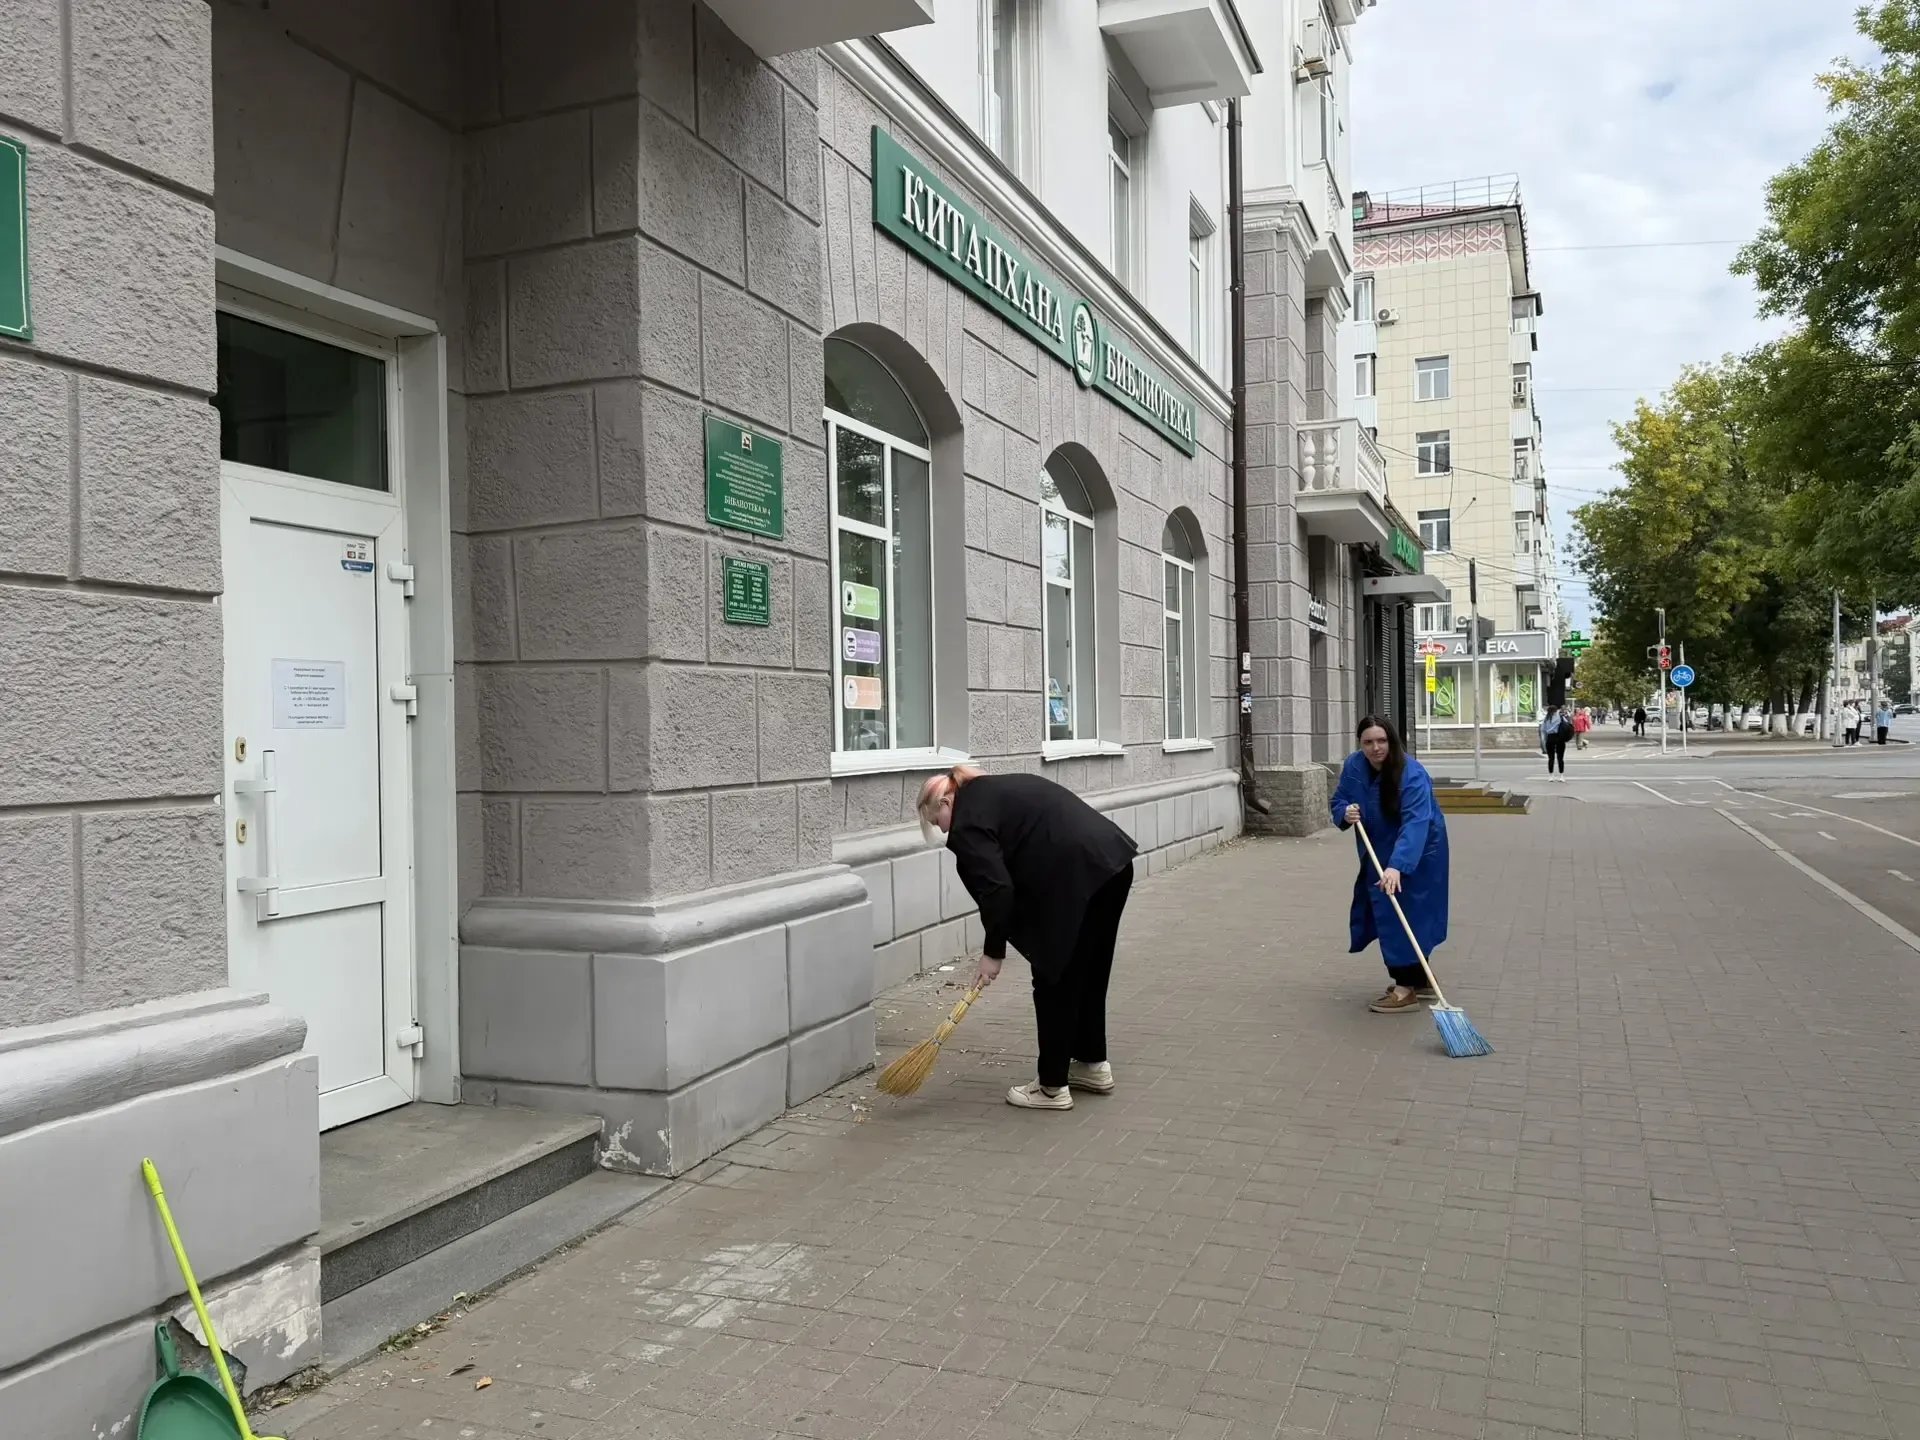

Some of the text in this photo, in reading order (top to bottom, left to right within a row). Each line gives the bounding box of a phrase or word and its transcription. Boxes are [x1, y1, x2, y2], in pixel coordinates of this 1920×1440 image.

[901, 164, 1066, 345] КИТАПХАНА
[1105, 341, 1192, 442] БИБЛИОТЕКА
[1452, 640, 1520, 655] АЕКА
